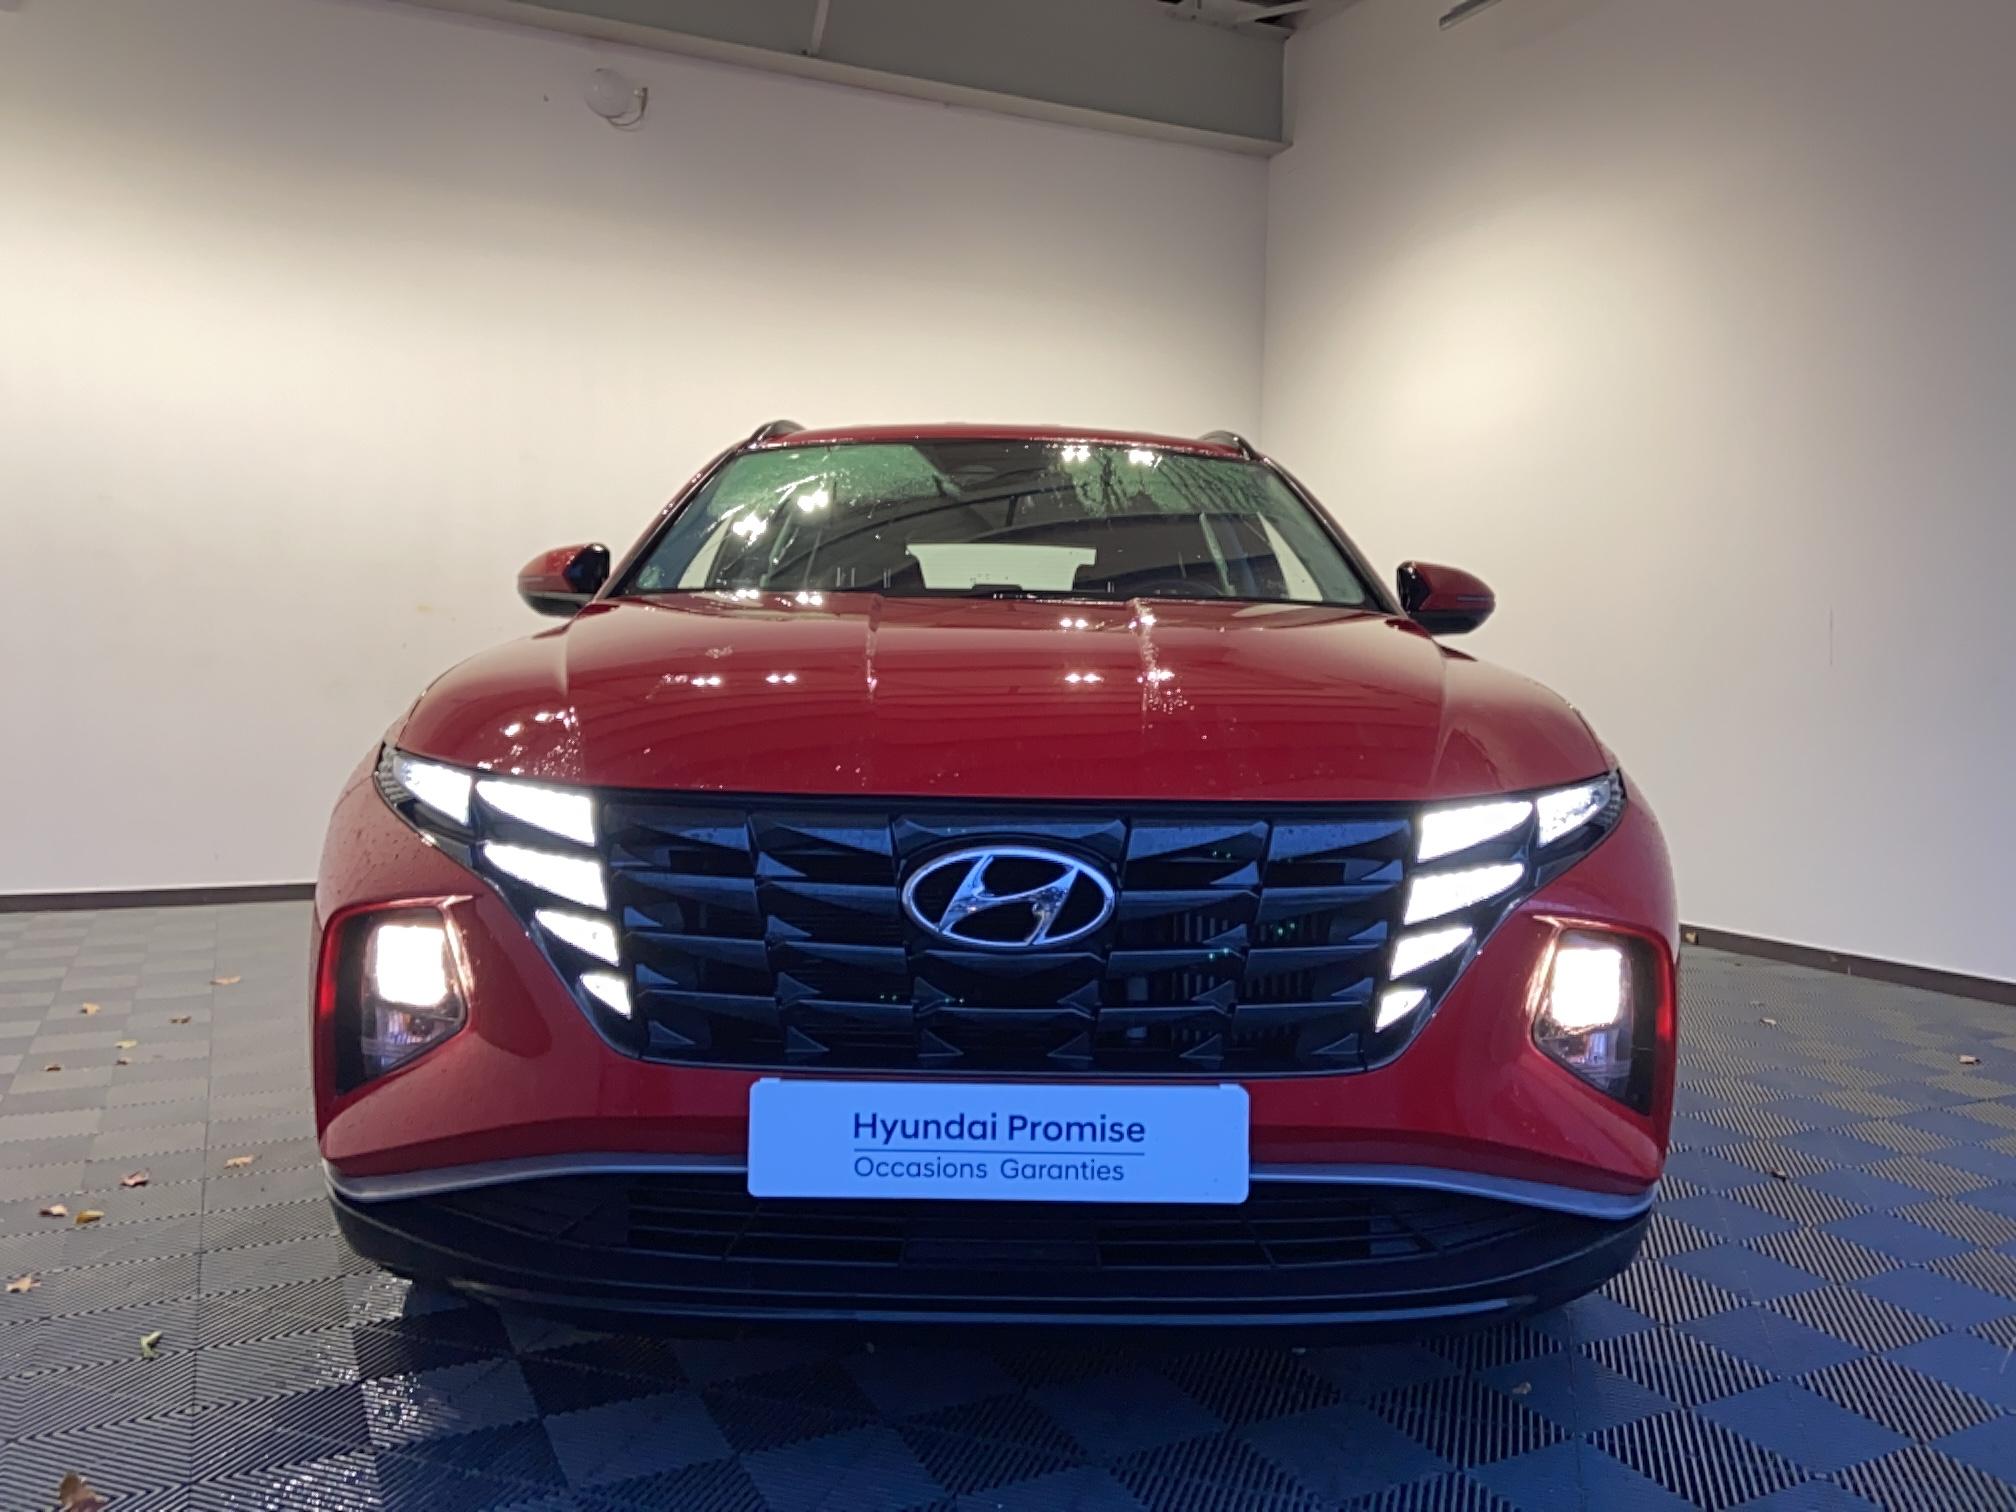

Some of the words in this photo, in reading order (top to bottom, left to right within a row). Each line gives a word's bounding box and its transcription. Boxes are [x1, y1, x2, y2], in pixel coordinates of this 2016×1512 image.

[852, 1111, 998, 1146] Hyundai
[1007, 1113, 1146, 1144] Promise
[853, 1155, 988, 1179] Occasions
[999, 1157, 1125, 1182] Garanties
